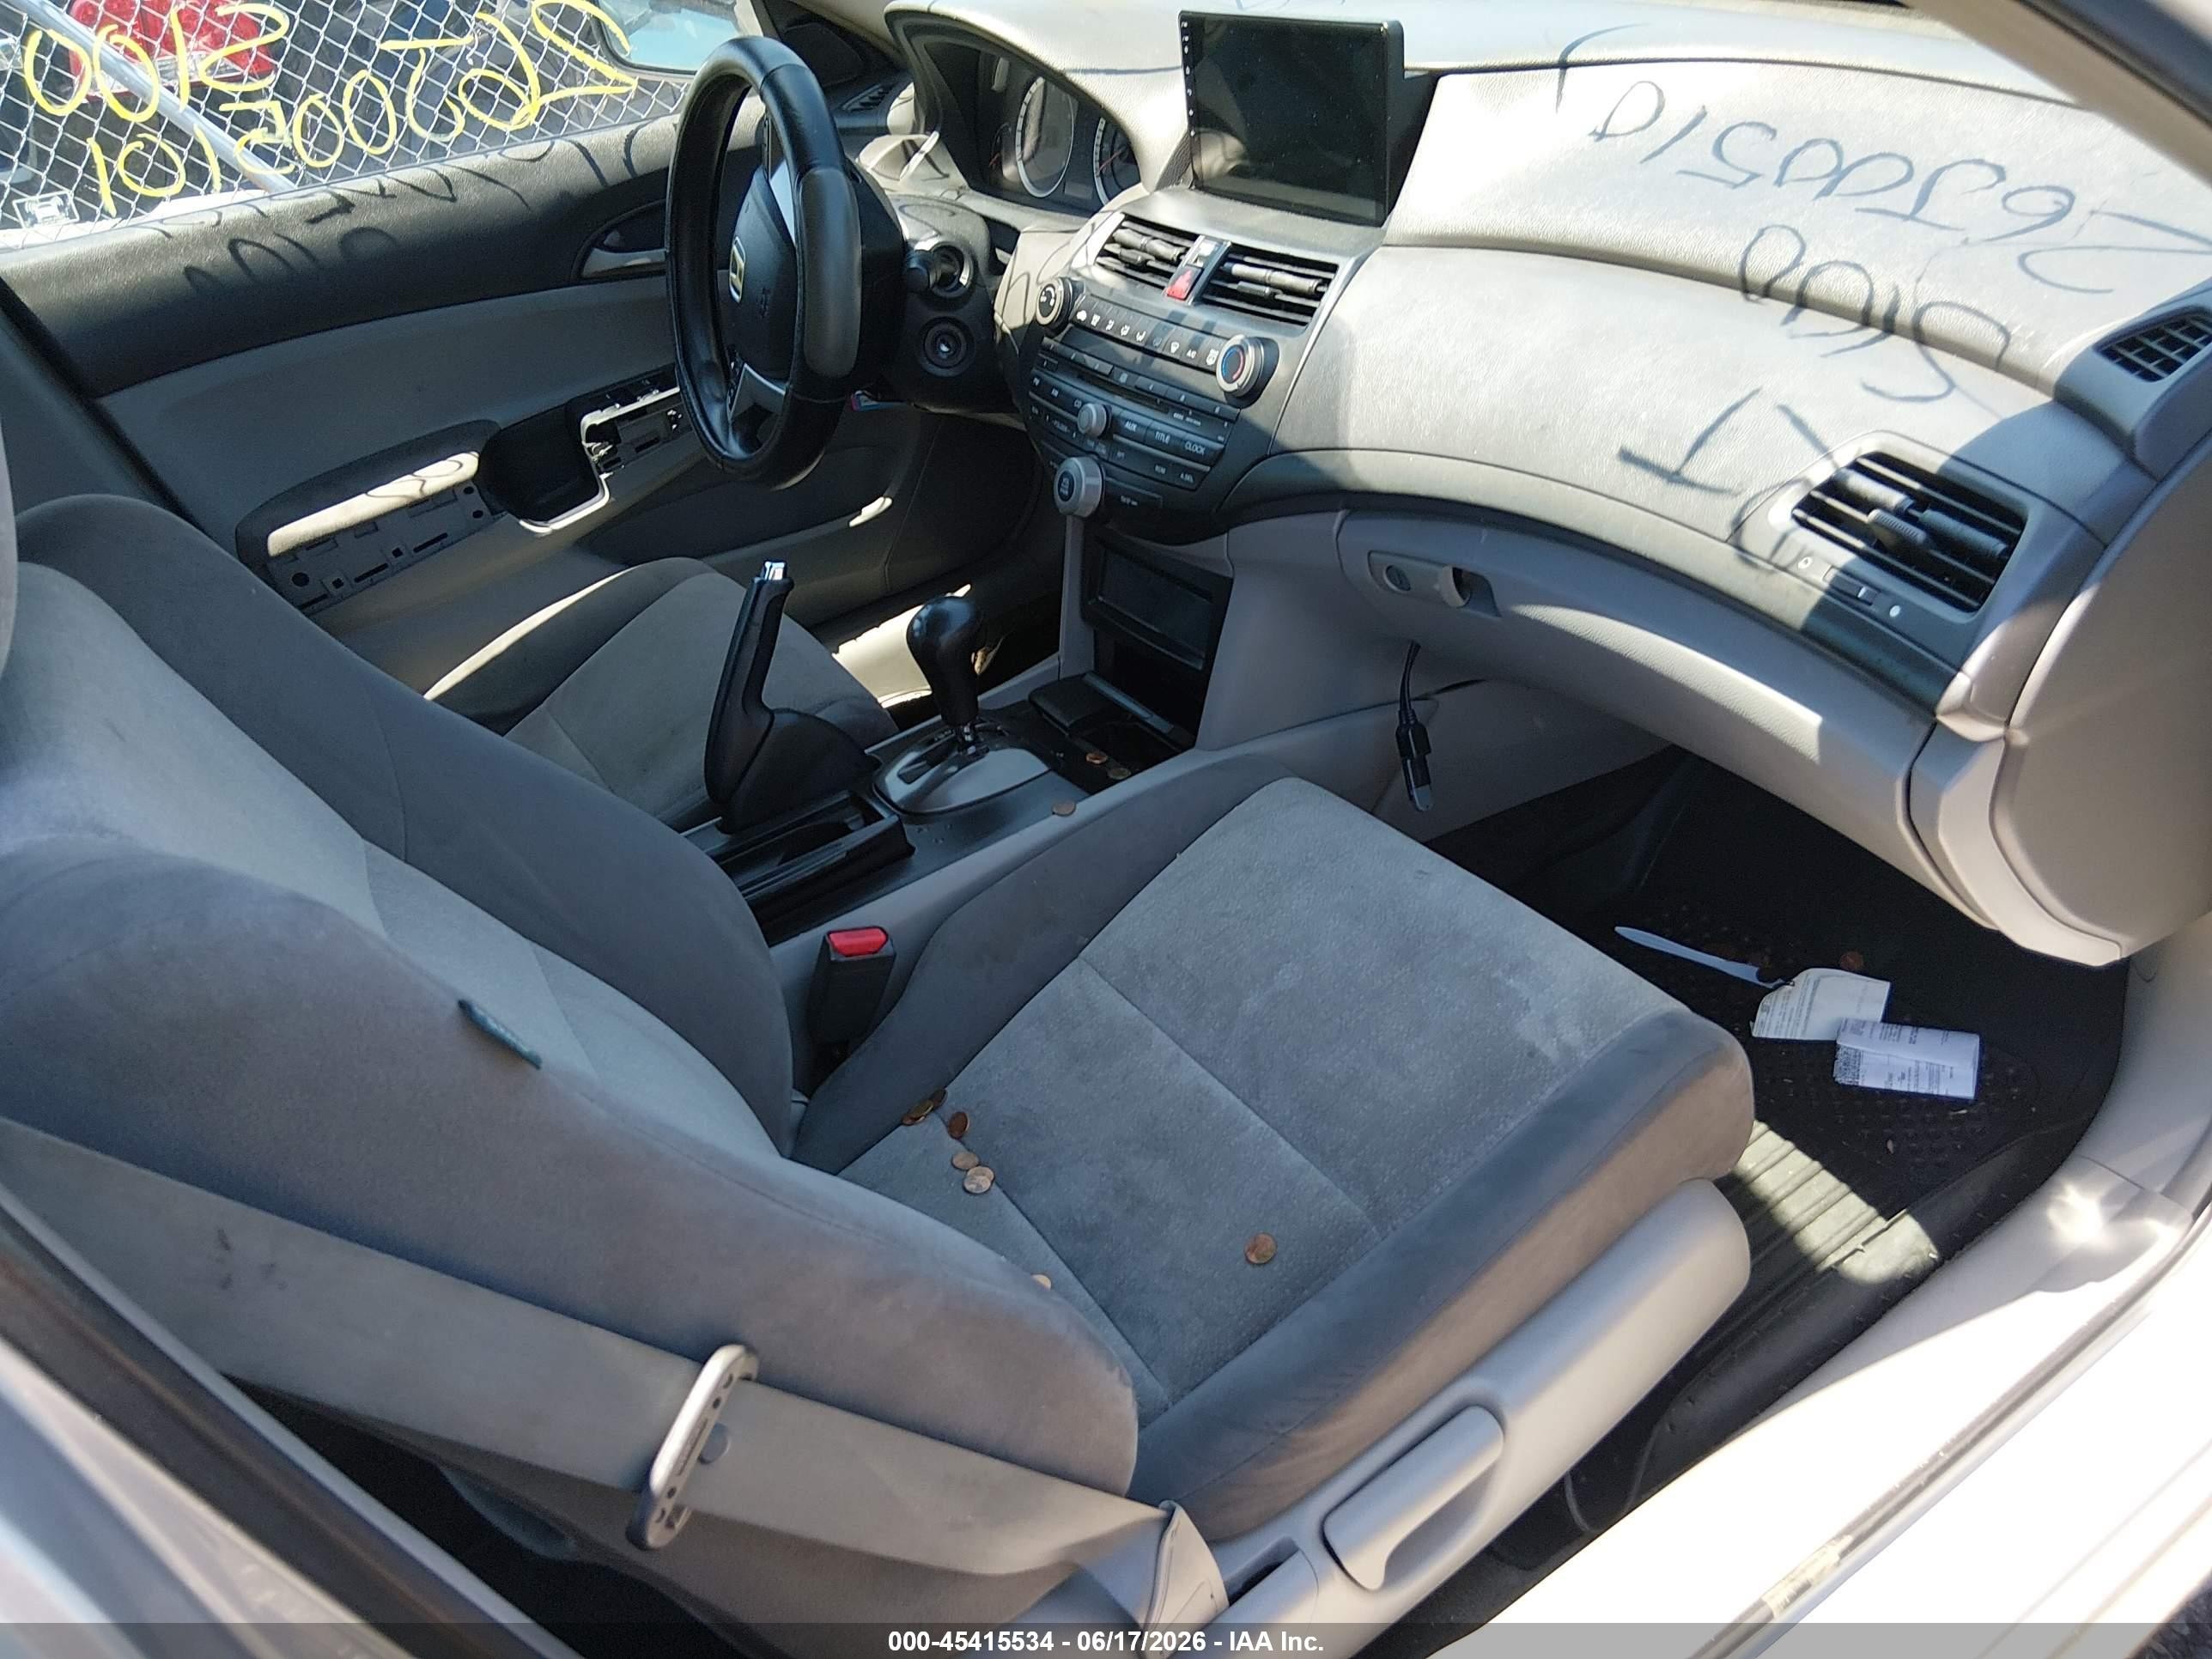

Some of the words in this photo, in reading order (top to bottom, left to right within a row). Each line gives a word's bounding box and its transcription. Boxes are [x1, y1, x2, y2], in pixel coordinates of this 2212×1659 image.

[1125, 420, 1138, 432] AUX
[1155, 431, 1170, 445] TITLE
[1185, 441, 1206, 455] CLOCK
